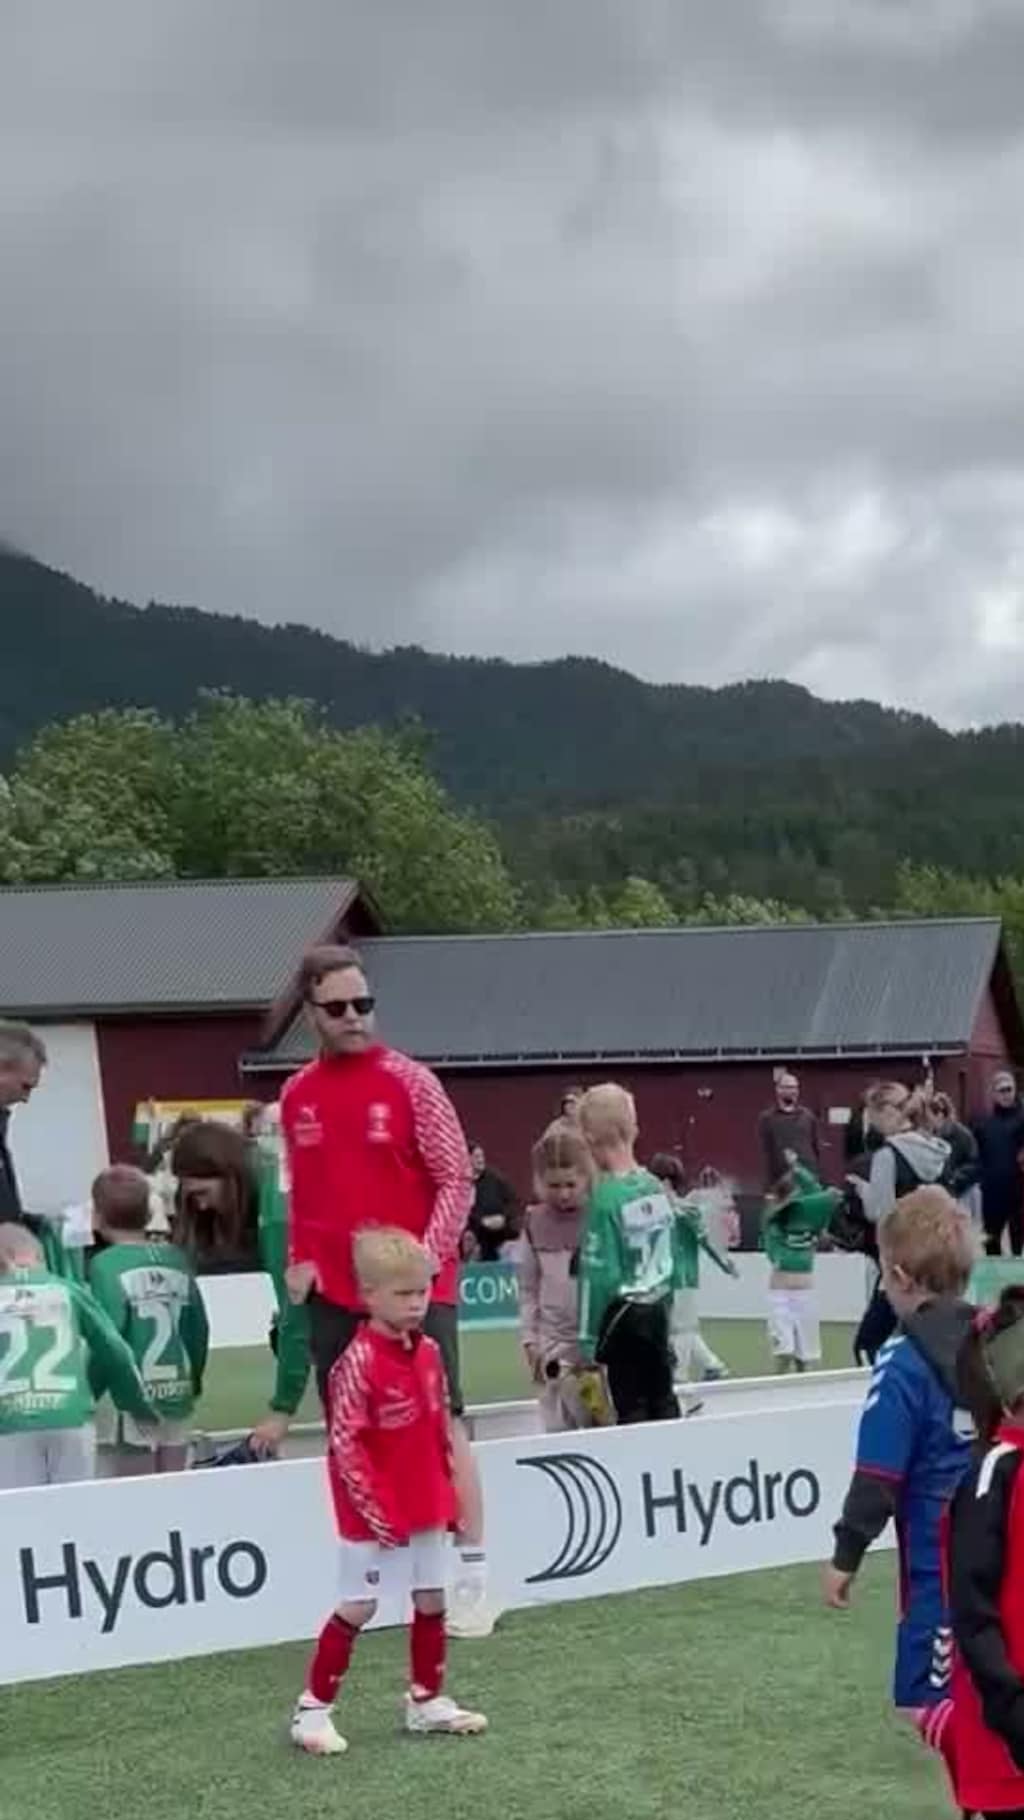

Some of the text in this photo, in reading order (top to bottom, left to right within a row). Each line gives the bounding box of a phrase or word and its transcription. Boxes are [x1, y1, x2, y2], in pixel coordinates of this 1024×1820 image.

[459, 1276, 520, 1305] COM
[0, 1313, 77, 1395] 22
[138, 1300, 178, 1382] 2
[642, 1459, 820, 1546] Hydro
[19, 1530, 267, 1634] Hydro
